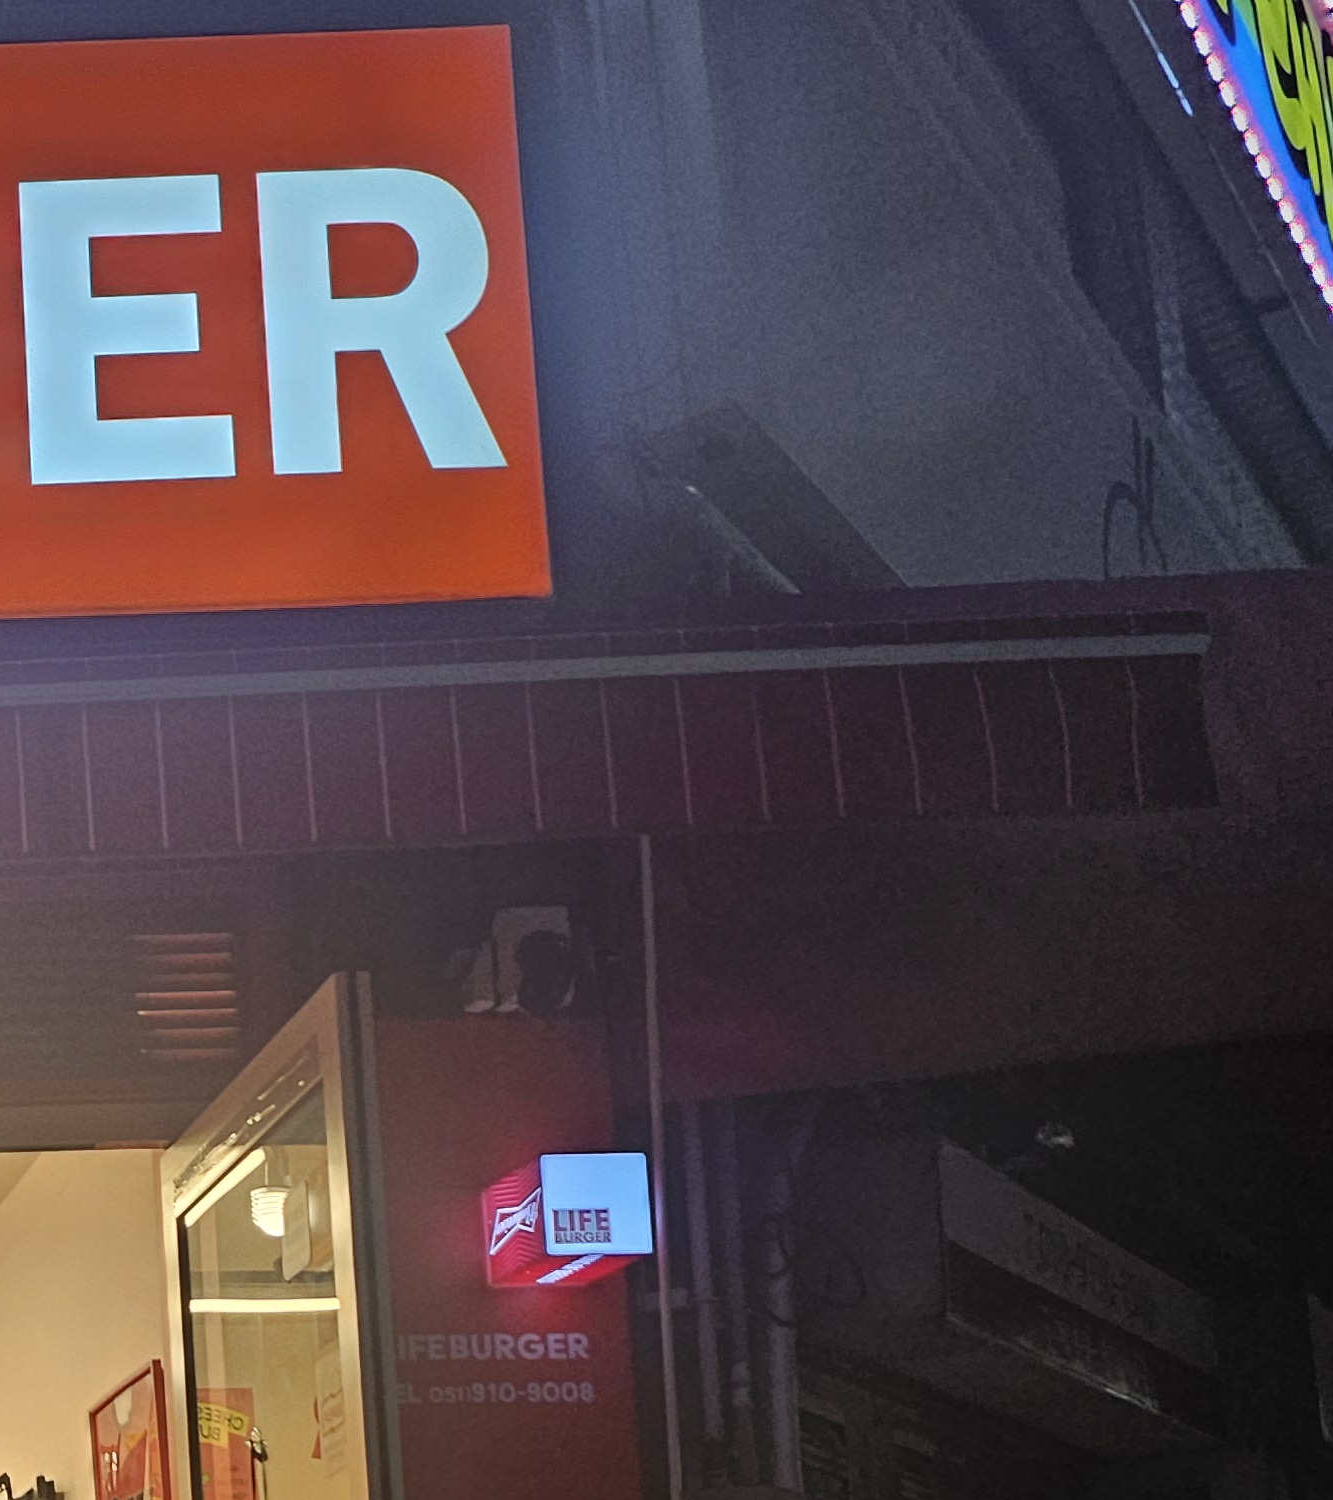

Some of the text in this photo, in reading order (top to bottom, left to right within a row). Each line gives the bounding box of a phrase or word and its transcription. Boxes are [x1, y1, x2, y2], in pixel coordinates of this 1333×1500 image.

[552, 1208, 610, 1231] LIFE
[554, 1231, 613, 1244] BURGER
[393, 1333, 590, 1360] IFEBURGER
